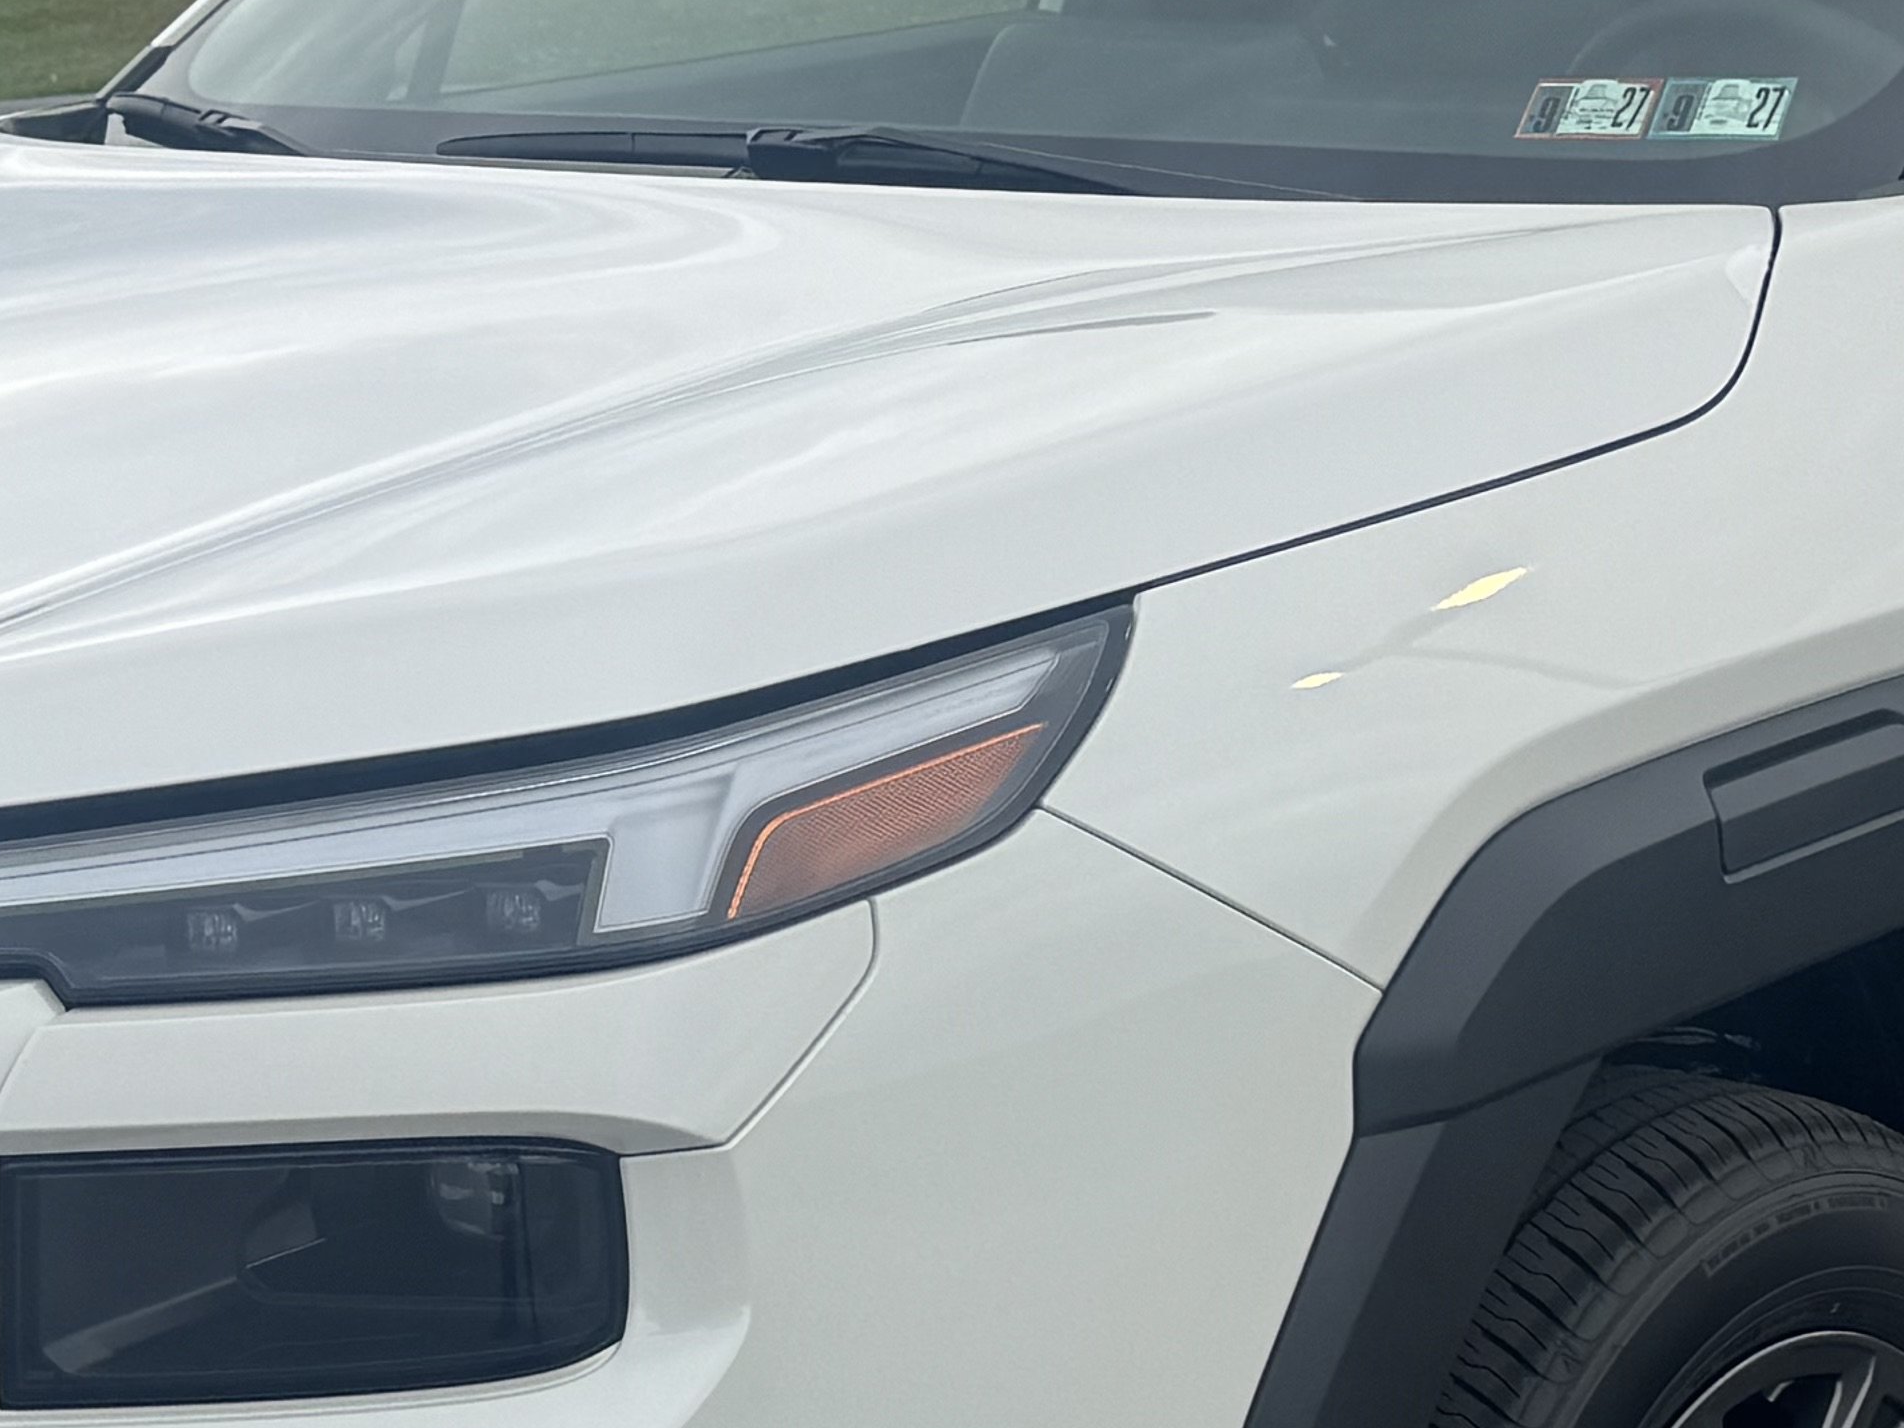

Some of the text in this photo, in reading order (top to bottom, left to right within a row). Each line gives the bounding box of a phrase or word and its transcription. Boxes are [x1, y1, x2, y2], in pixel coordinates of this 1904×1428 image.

[1532, 97, 1561, 133] 9
[1611, 87, 1651, 130] 27
[1666, 87, 1786, 132] 9 27
